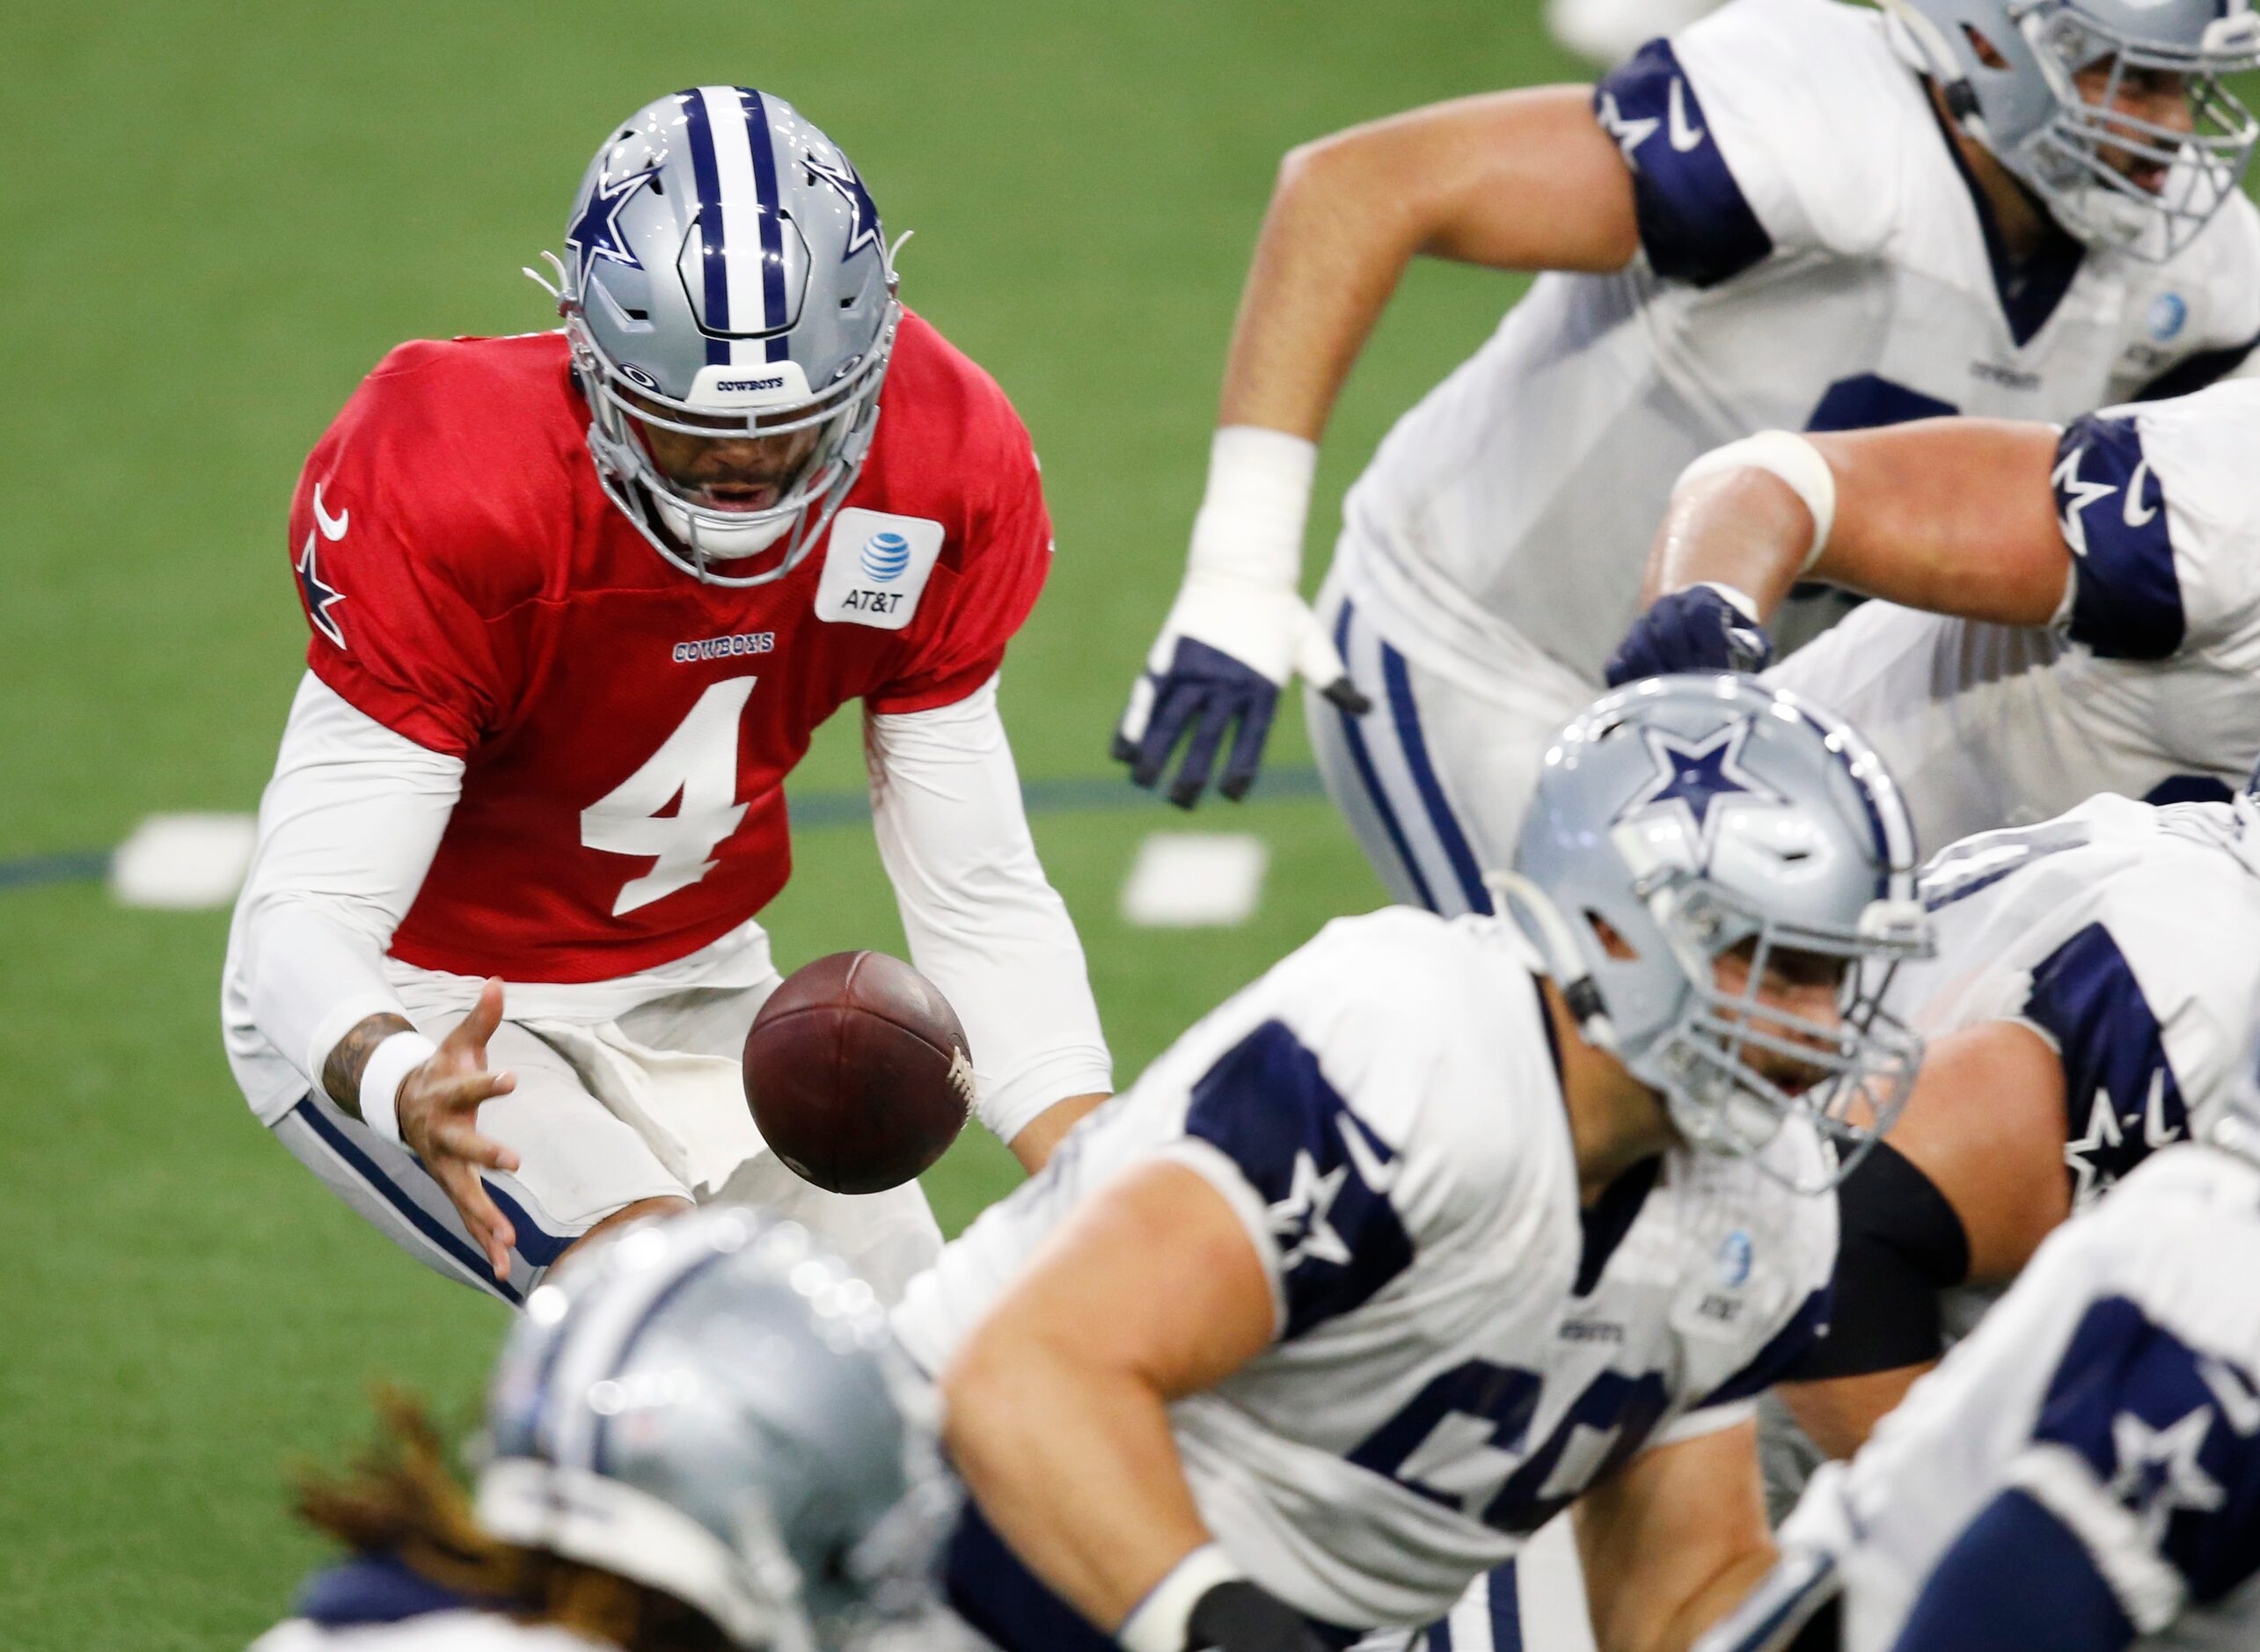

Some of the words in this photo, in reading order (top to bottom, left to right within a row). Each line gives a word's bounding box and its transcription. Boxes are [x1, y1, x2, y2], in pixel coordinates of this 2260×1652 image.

[717, 377, 784, 391] COWBOYS
[842, 588, 903, 614] AT&T
[673, 632, 775, 662] COWBOYS
[580, 675, 757, 917] 4
